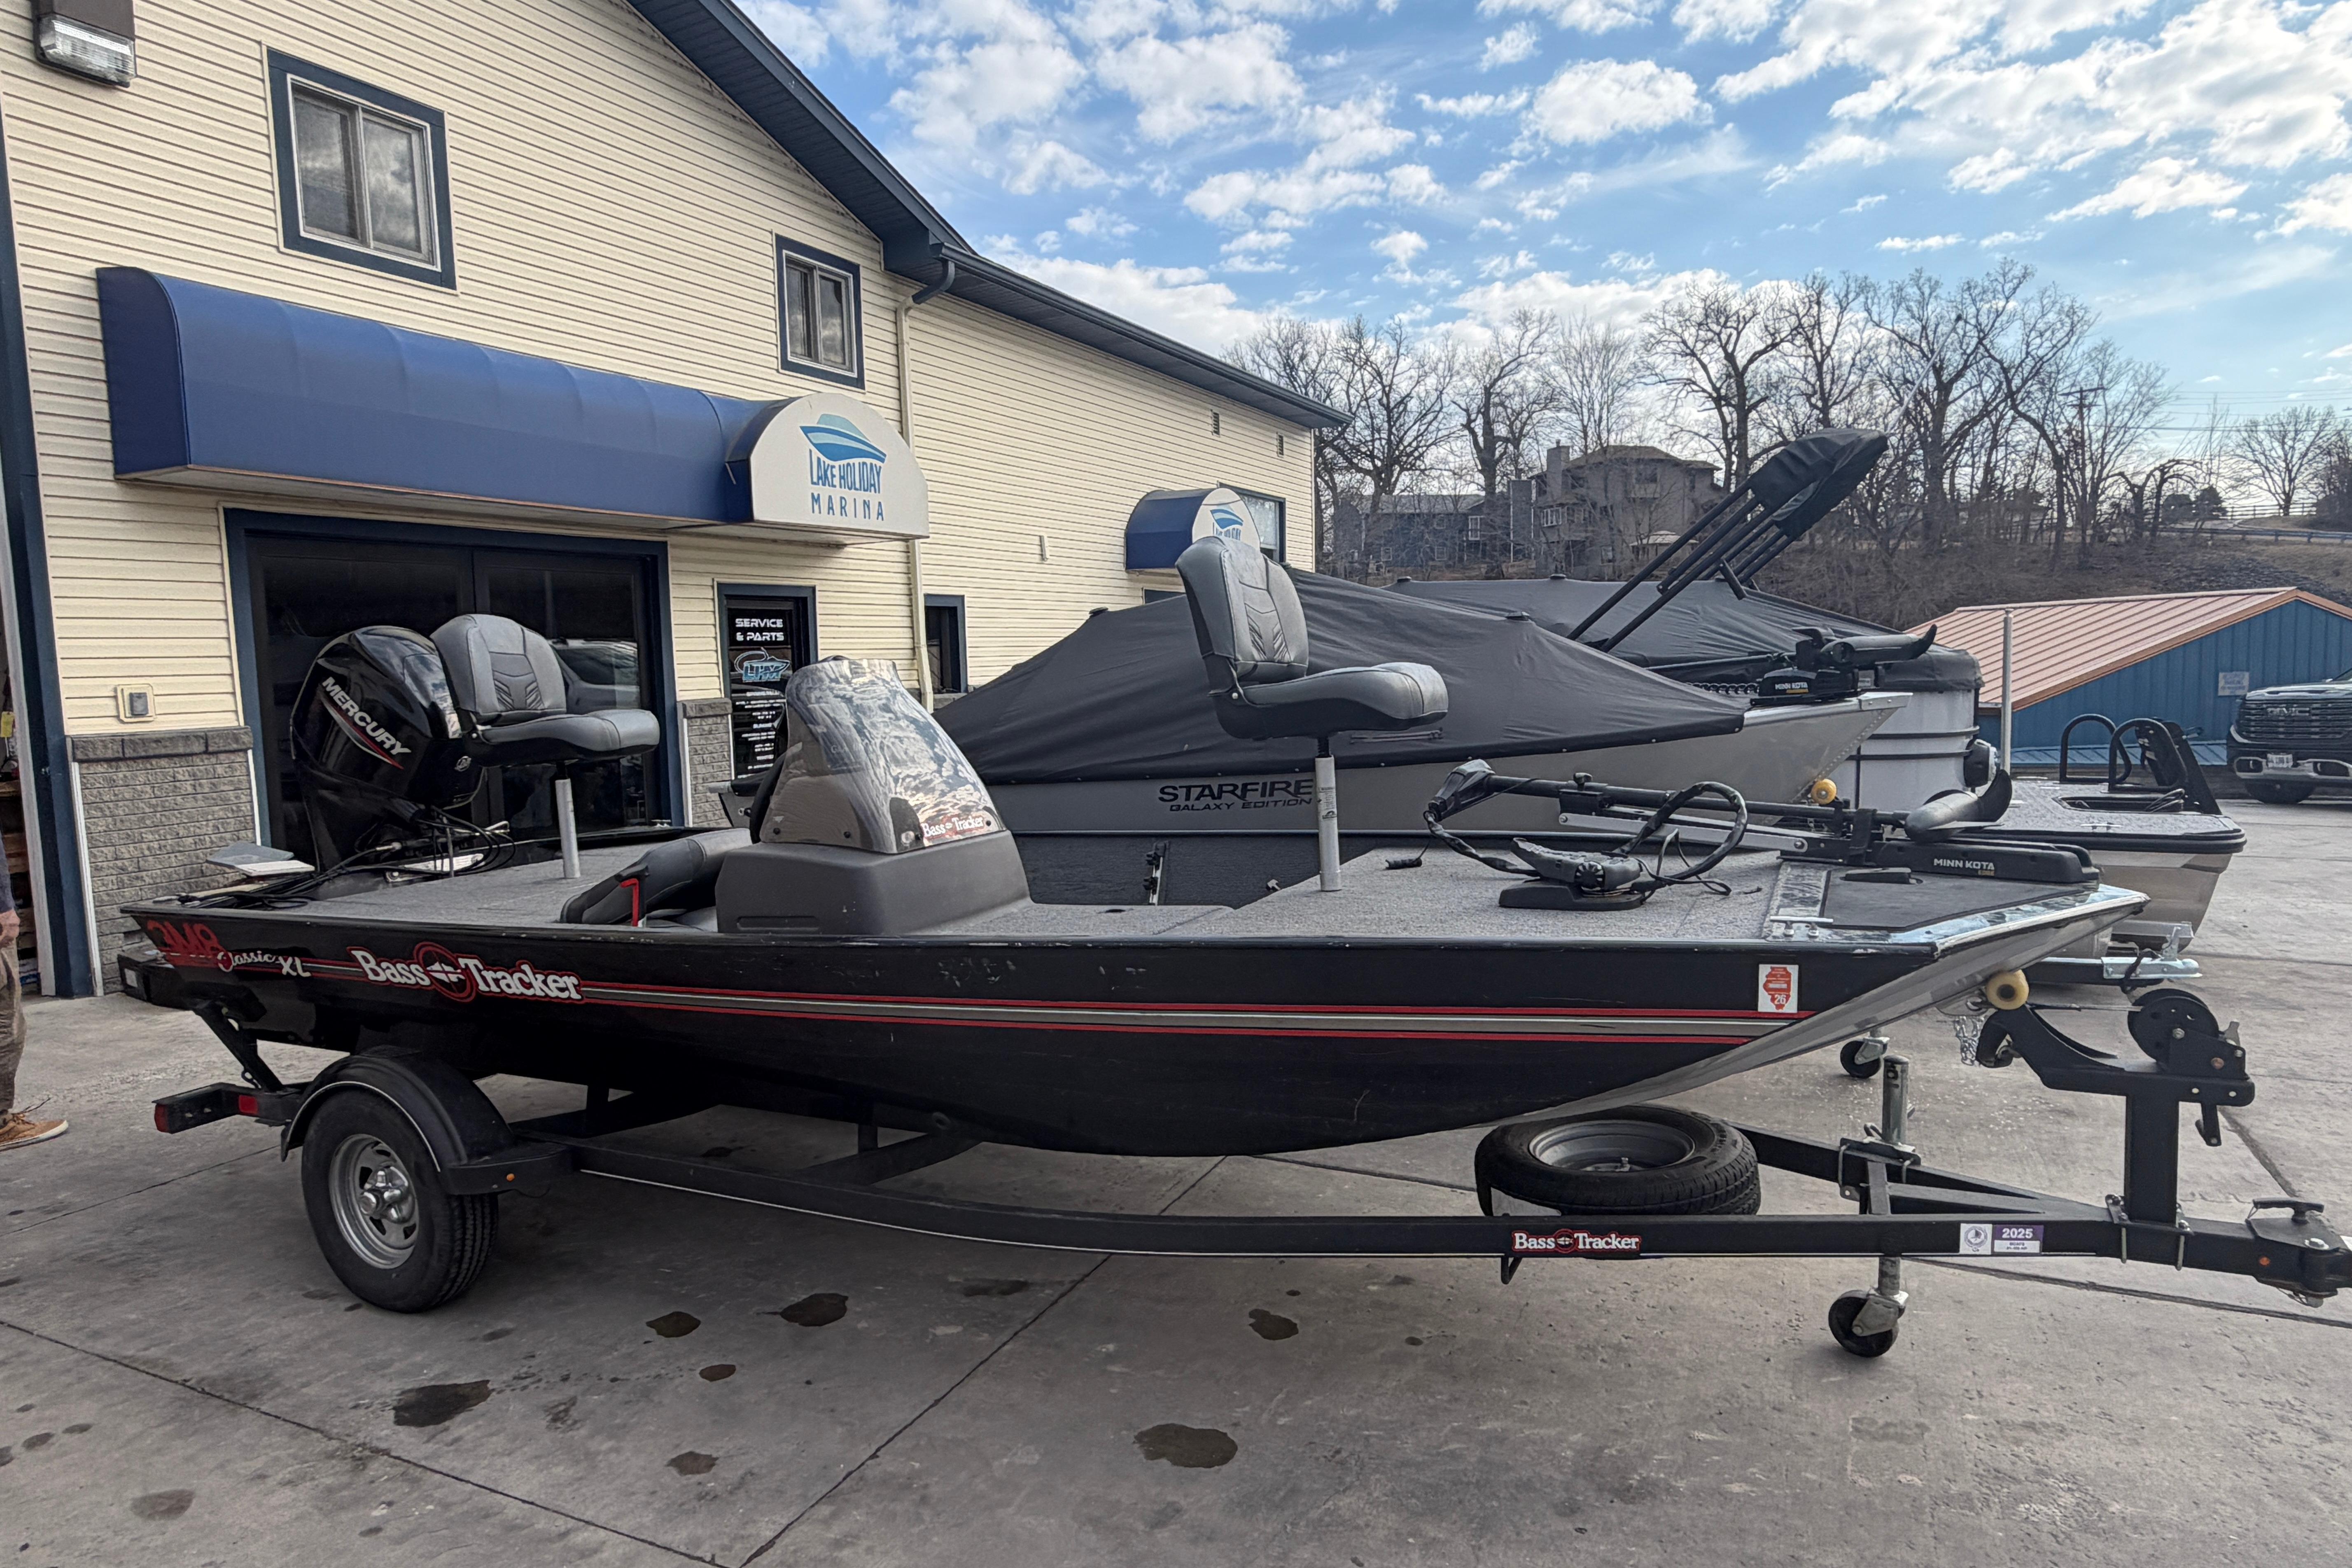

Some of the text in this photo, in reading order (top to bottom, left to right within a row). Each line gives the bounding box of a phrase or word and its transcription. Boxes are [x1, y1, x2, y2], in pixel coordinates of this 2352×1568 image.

[809, 448, 882, 494] LAKE HOLIDAY
[811, 492, 884, 521] MARINA
[735, 618, 783, 628] SERVICE
[746, 632, 784, 641] PARTS
[322, 677, 411, 755] MERCURY
[1158, 779, 1314, 802] STARFIRE
[1169, 798, 1313, 812] GALAXY EDITION
[921, 815, 984, 837] Bass Tracker
[1934, 858, 1995, 870] MINN KOTA
[217, 950, 312, 977] Classic XL
[350, 950, 582, 999] Bass Tracker
[1514, 1232, 1639, 1249] Bass Tracker
[2002, 1228, 2034, 1239] 2025
